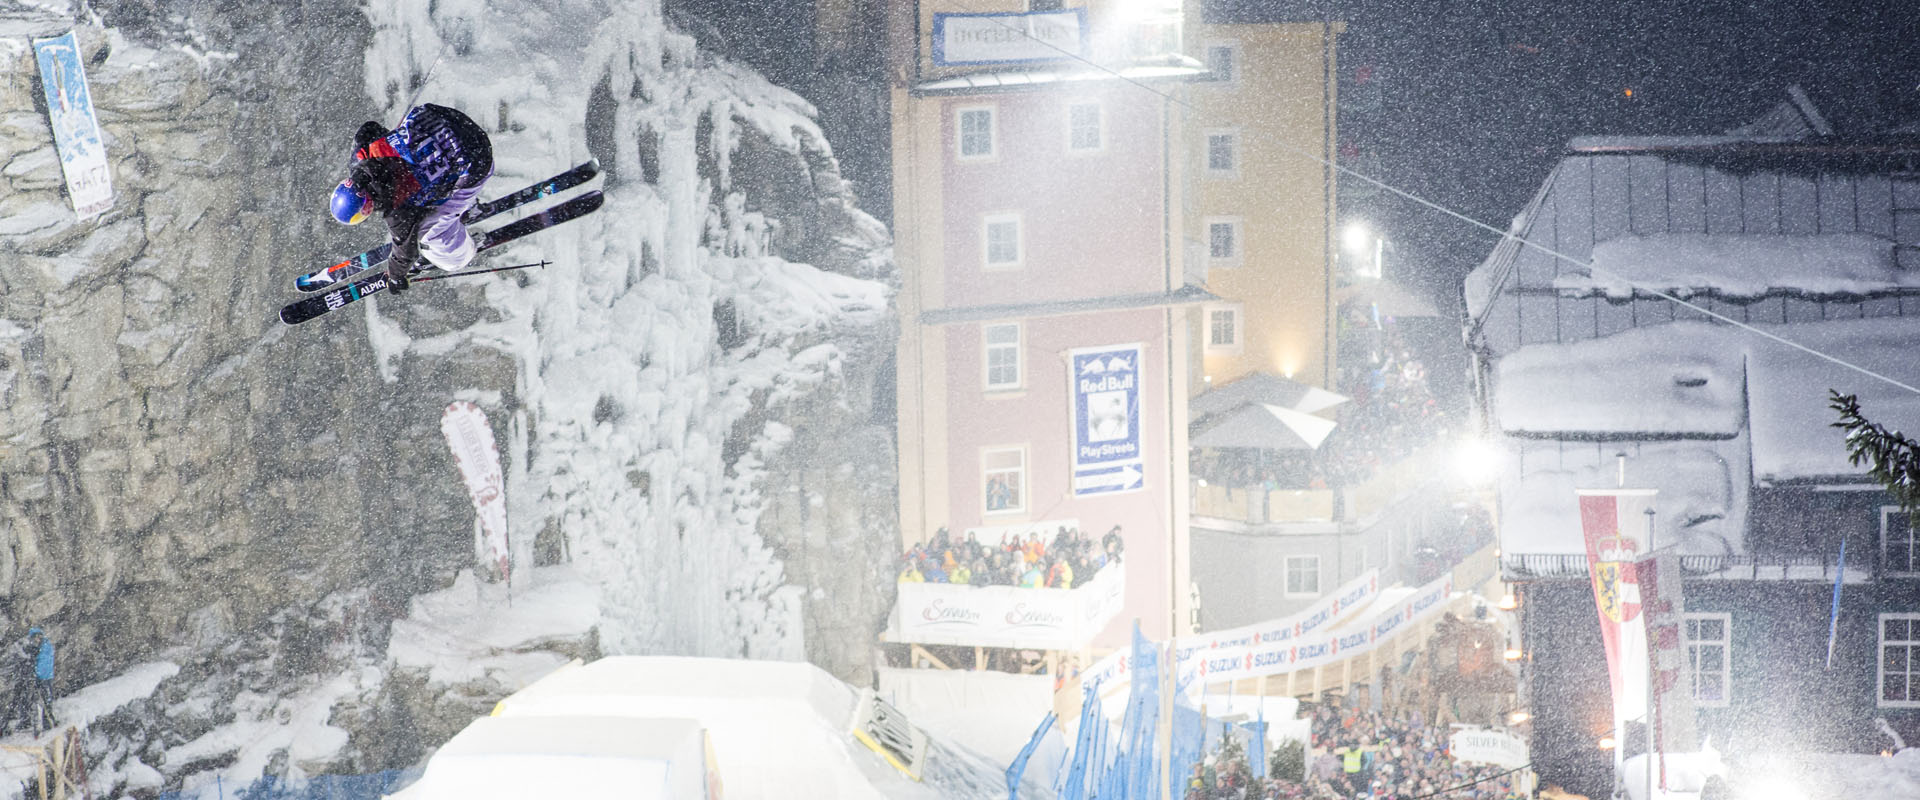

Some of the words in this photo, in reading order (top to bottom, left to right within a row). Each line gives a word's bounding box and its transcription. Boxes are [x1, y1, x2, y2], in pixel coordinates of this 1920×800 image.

[360, 280, 386, 296] ALPIQ
[1081, 377, 1107, 393] Red
[1108, 374, 1133, 391] Bull
[1302, 607, 1330, 634] SUZUKI
[1340, 583, 1368, 610] SUZUKI
[1209, 656, 1242, 673] SUZUKI
[1255, 650, 1287, 667] SUZUKI
[1299, 643, 1329, 660] SUZUKI
[1340, 630, 1367, 650] SUZUKI
[1377, 611, 1404, 638] SUZUKI
[1414, 588, 1443, 614] SUZUKI
[1466, 735, 1498, 748] SILVER
